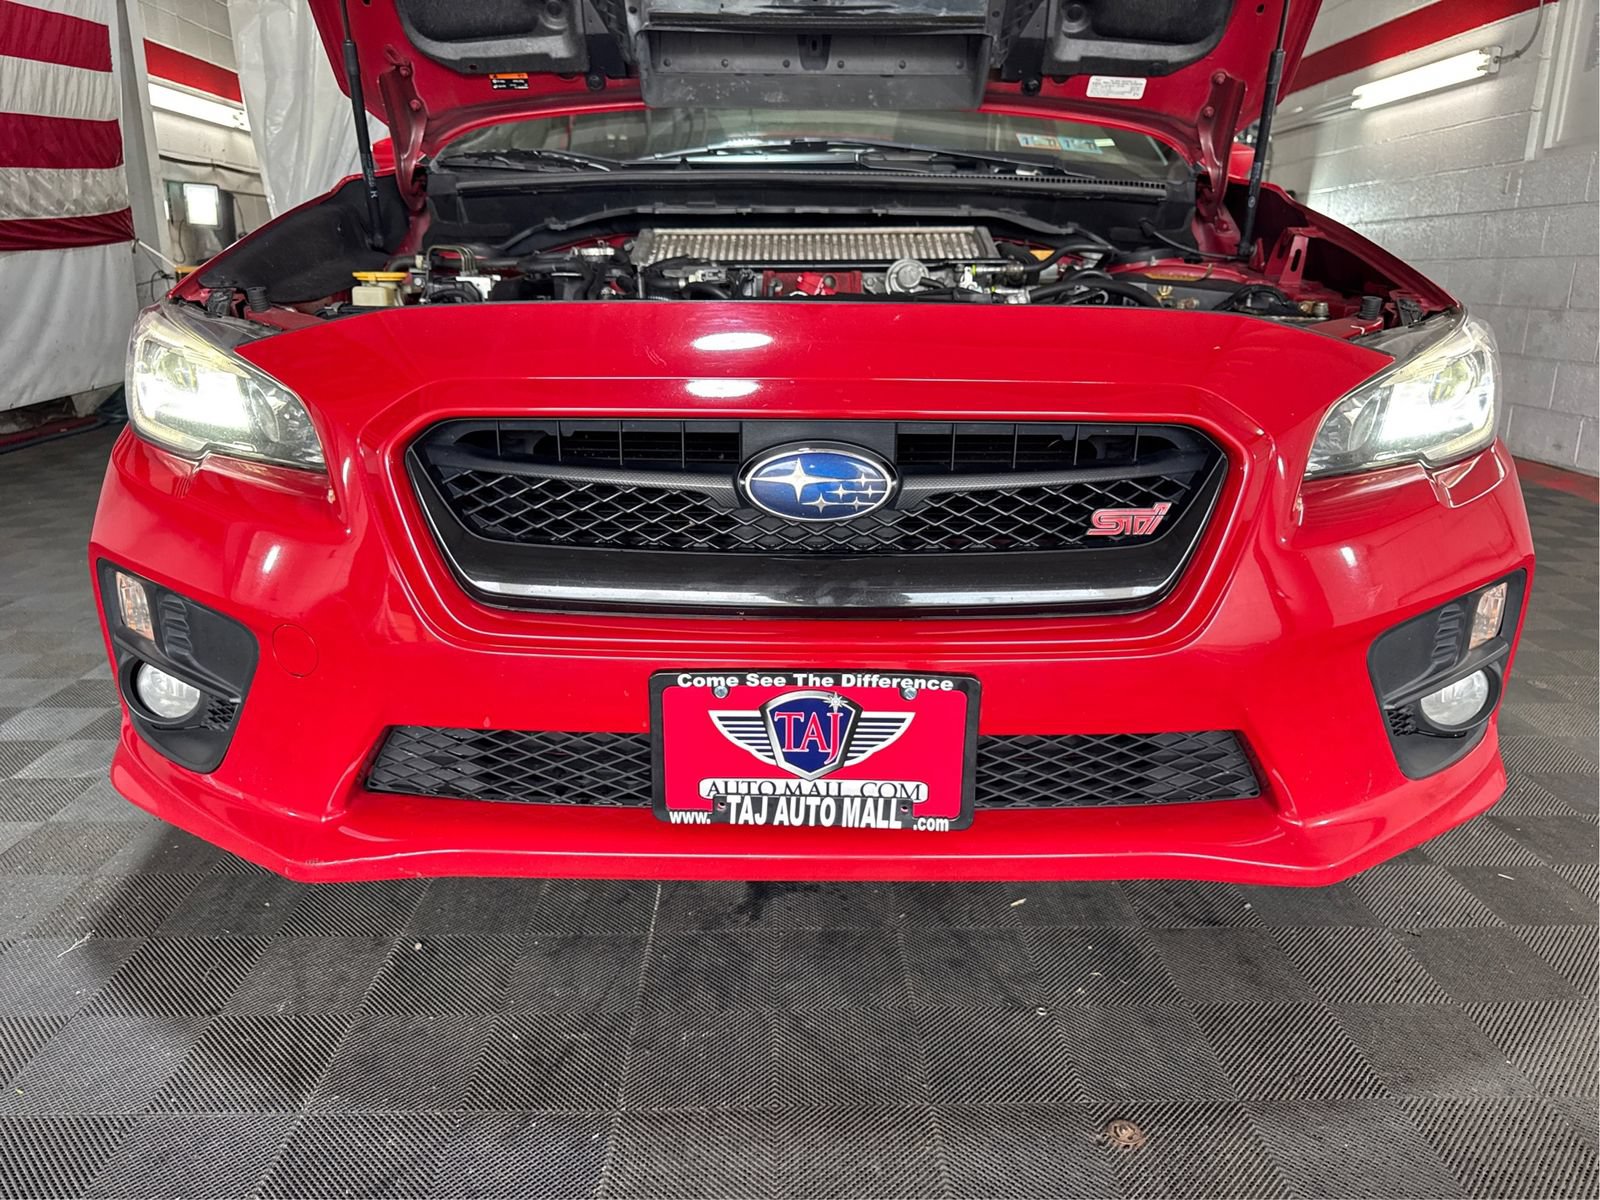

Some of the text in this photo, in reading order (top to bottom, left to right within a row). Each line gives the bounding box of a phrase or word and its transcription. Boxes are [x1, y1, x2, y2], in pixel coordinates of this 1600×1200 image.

[677, 673, 954, 691] Come See The Difference
[774, 711, 844, 765] TAJ
[669, 794, 950, 832] www. TAJ AUTO MALL .com
